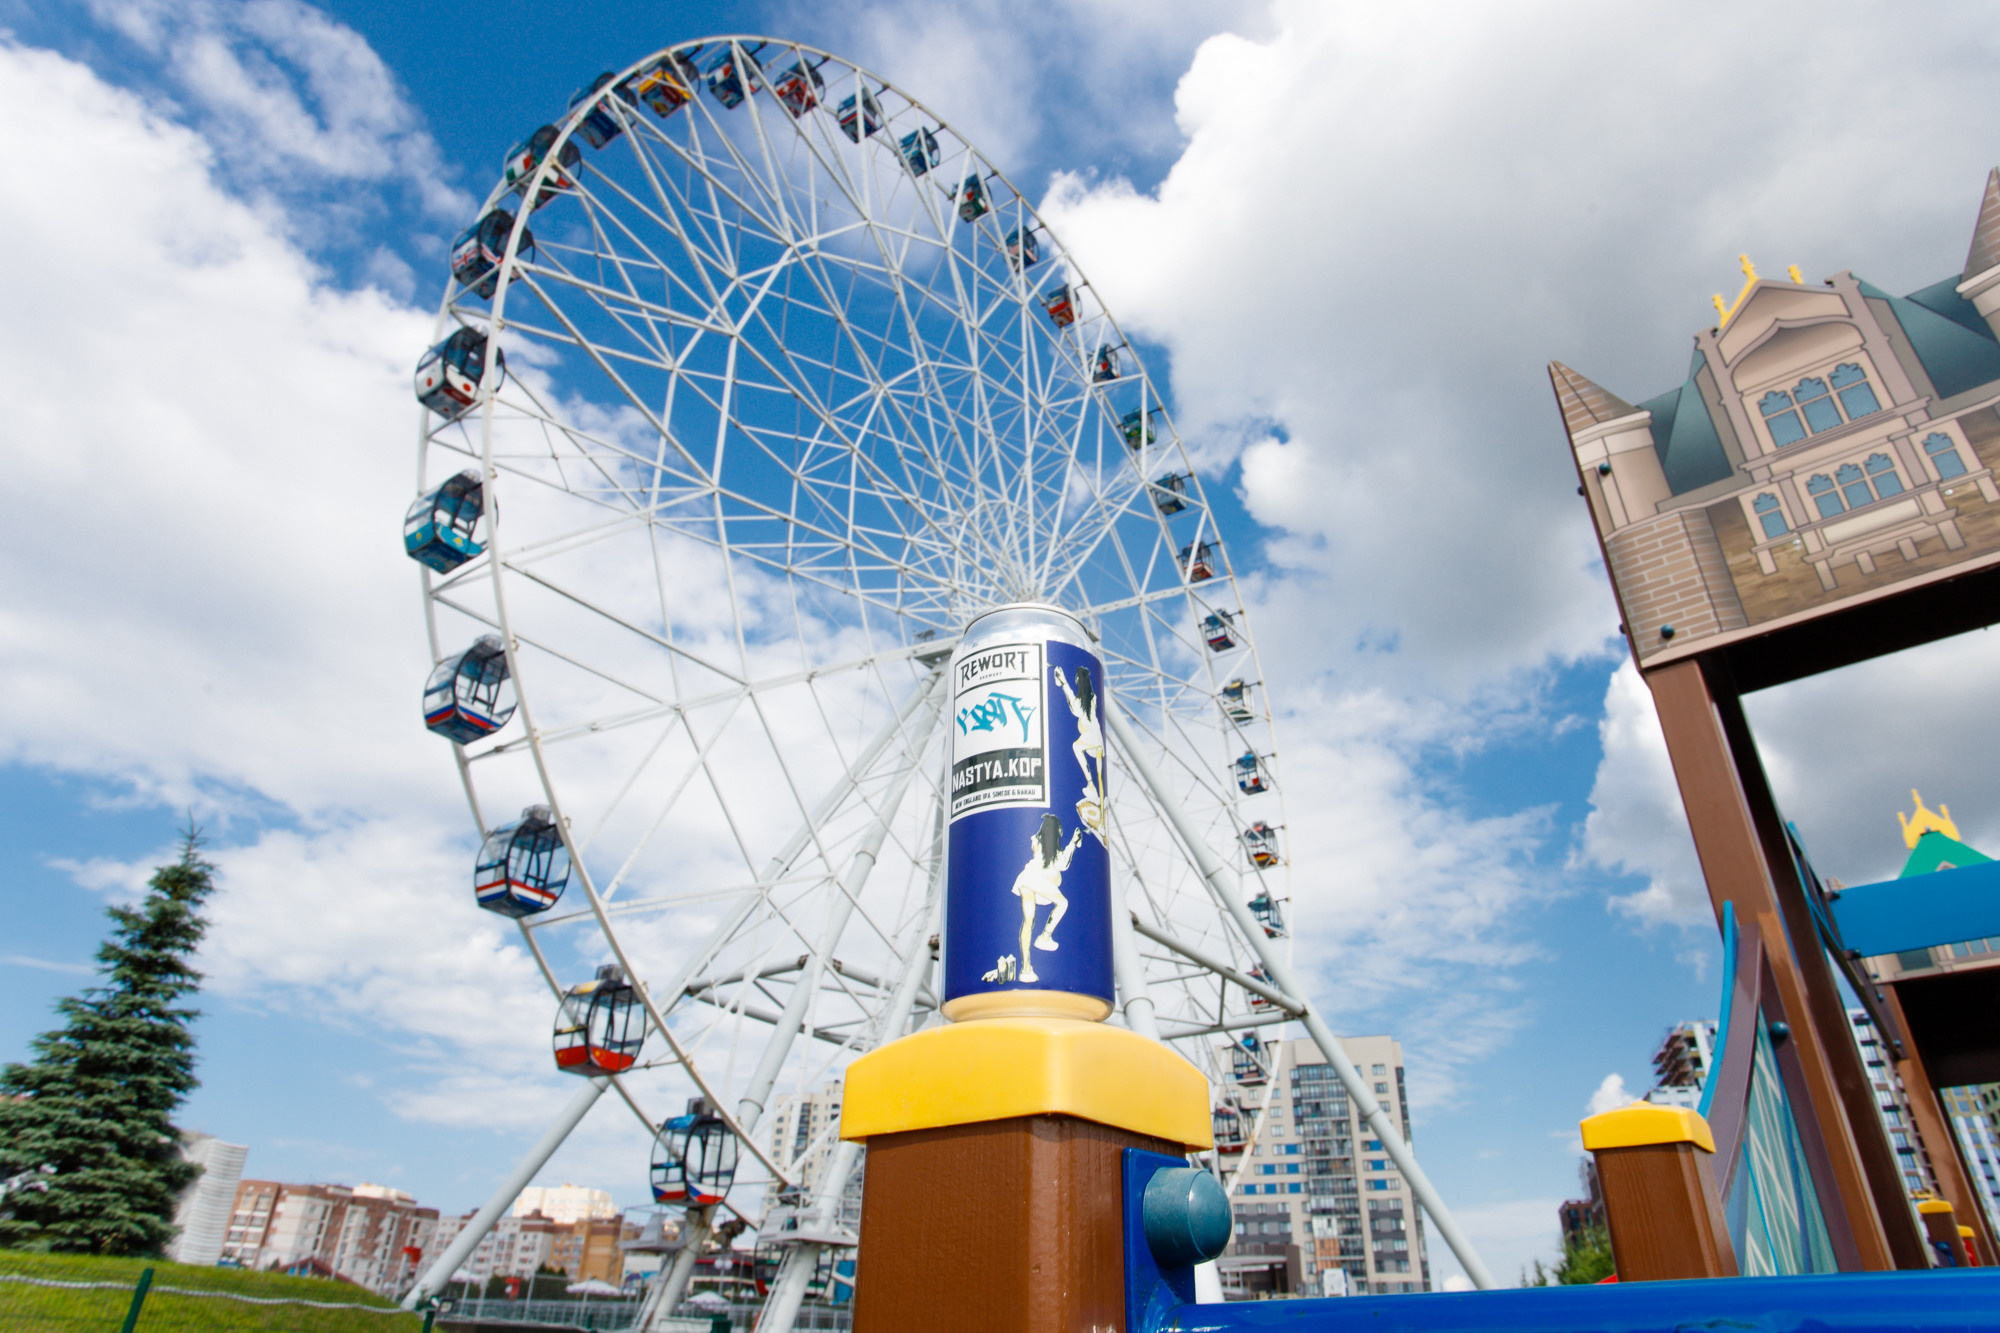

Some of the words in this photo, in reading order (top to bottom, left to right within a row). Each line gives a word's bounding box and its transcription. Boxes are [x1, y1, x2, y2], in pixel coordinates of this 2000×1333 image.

[961, 651, 1030, 688] REWORT
[955, 802, 963, 810] NEW
[963, 795, 982, 806] ENGLAND
